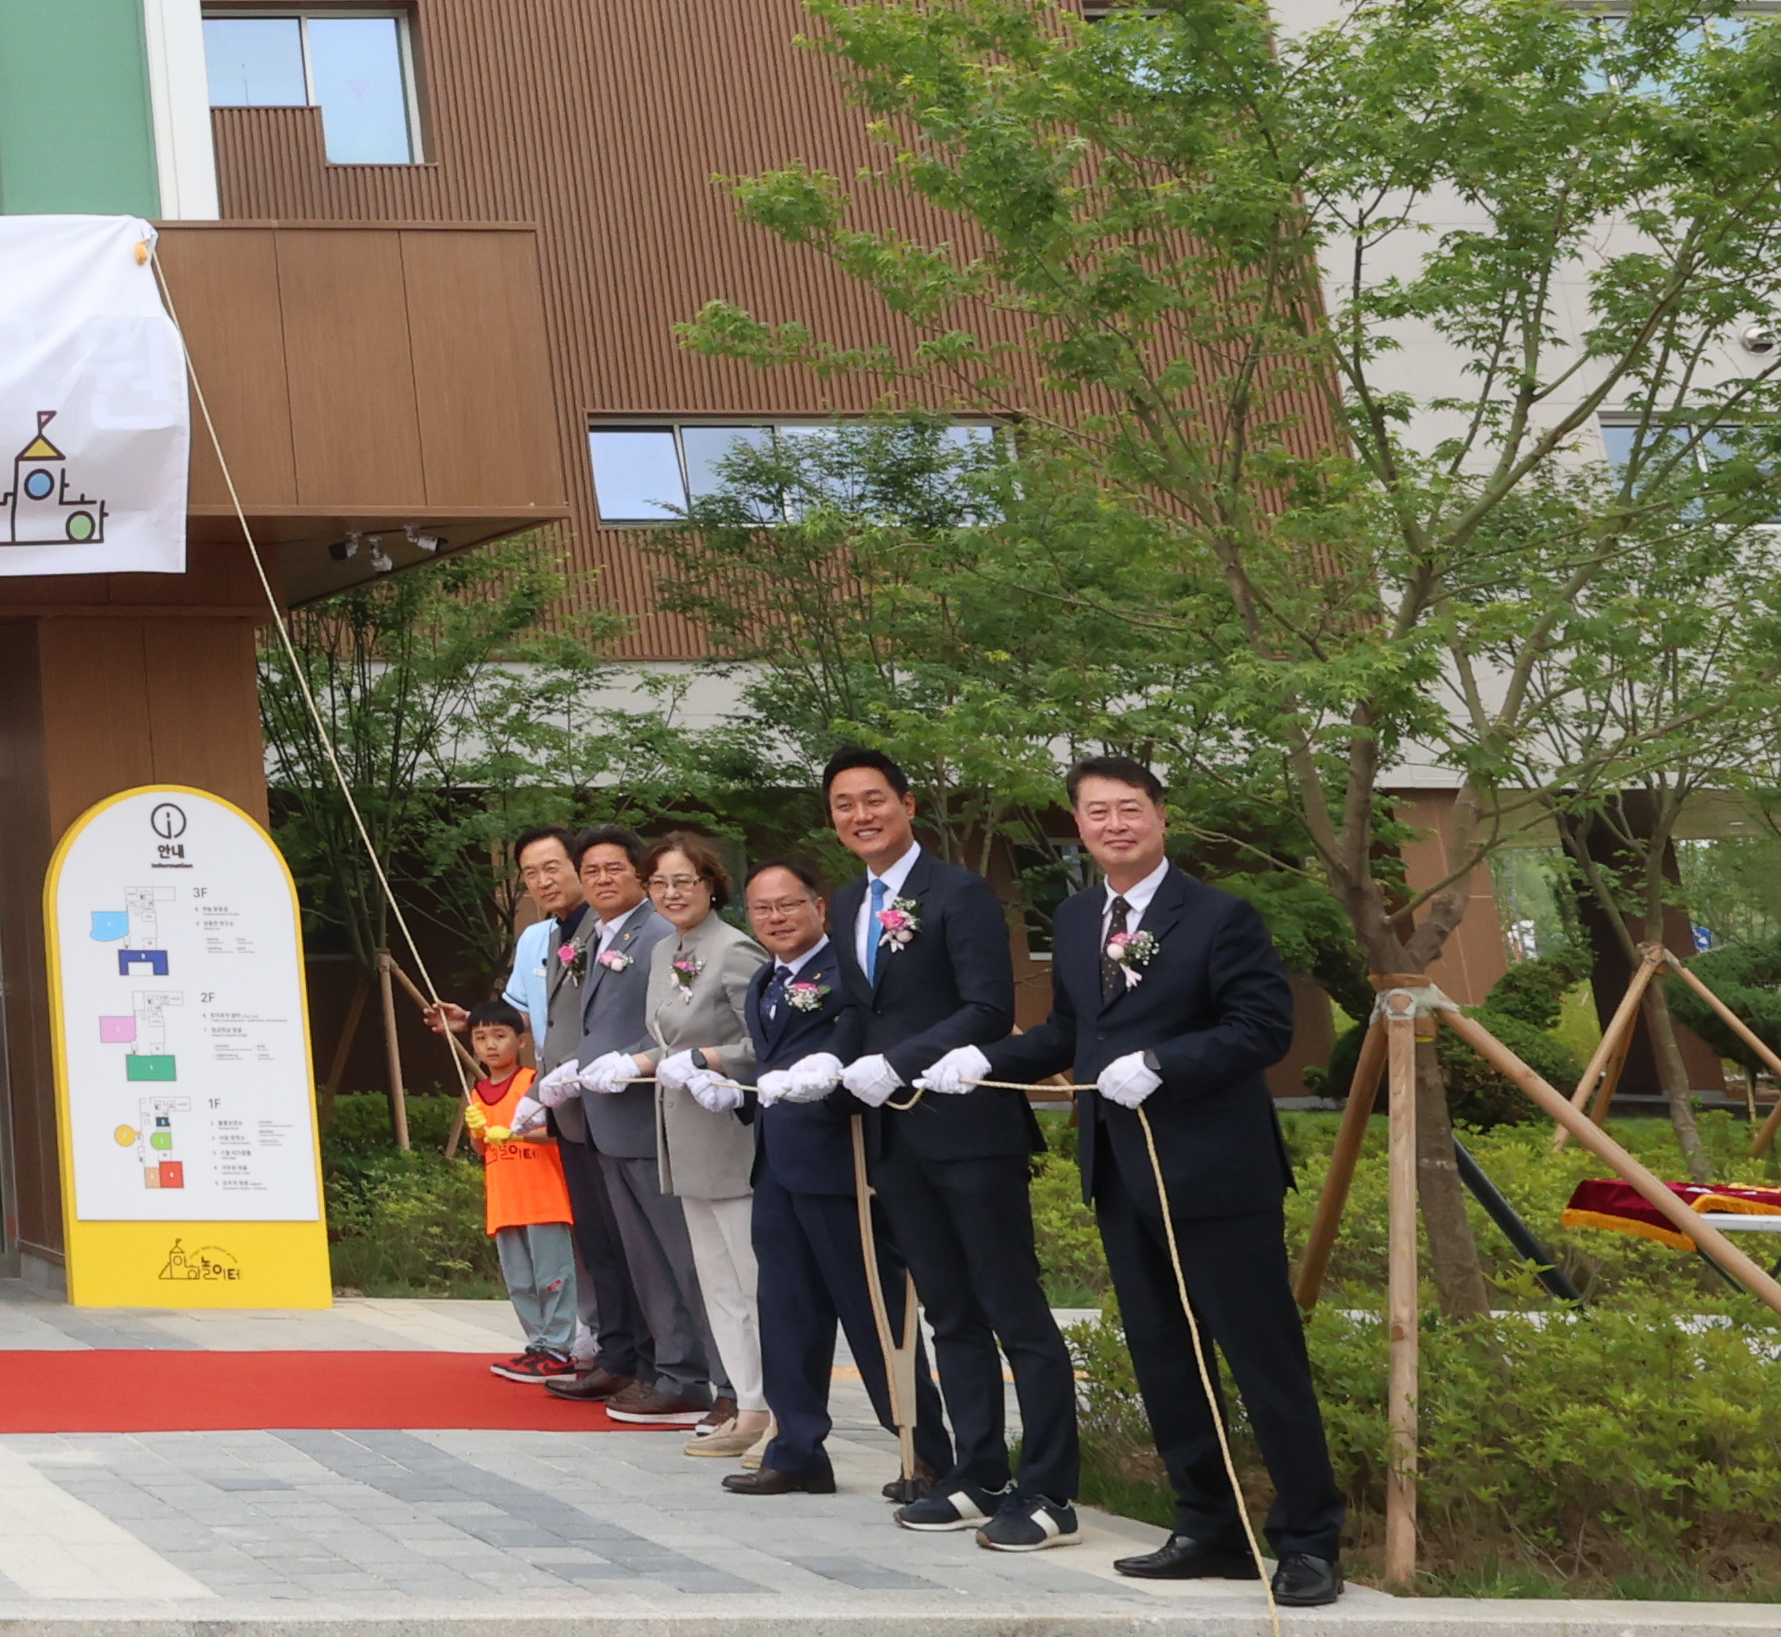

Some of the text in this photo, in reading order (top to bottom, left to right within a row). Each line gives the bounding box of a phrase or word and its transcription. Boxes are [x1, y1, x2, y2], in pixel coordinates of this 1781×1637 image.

[157, 843, 185, 859] 안내
[193, 887, 208, 898] 3F
[200, 992, 215, 1003] 2F
[208, 1098, 221, 1109] 1F
